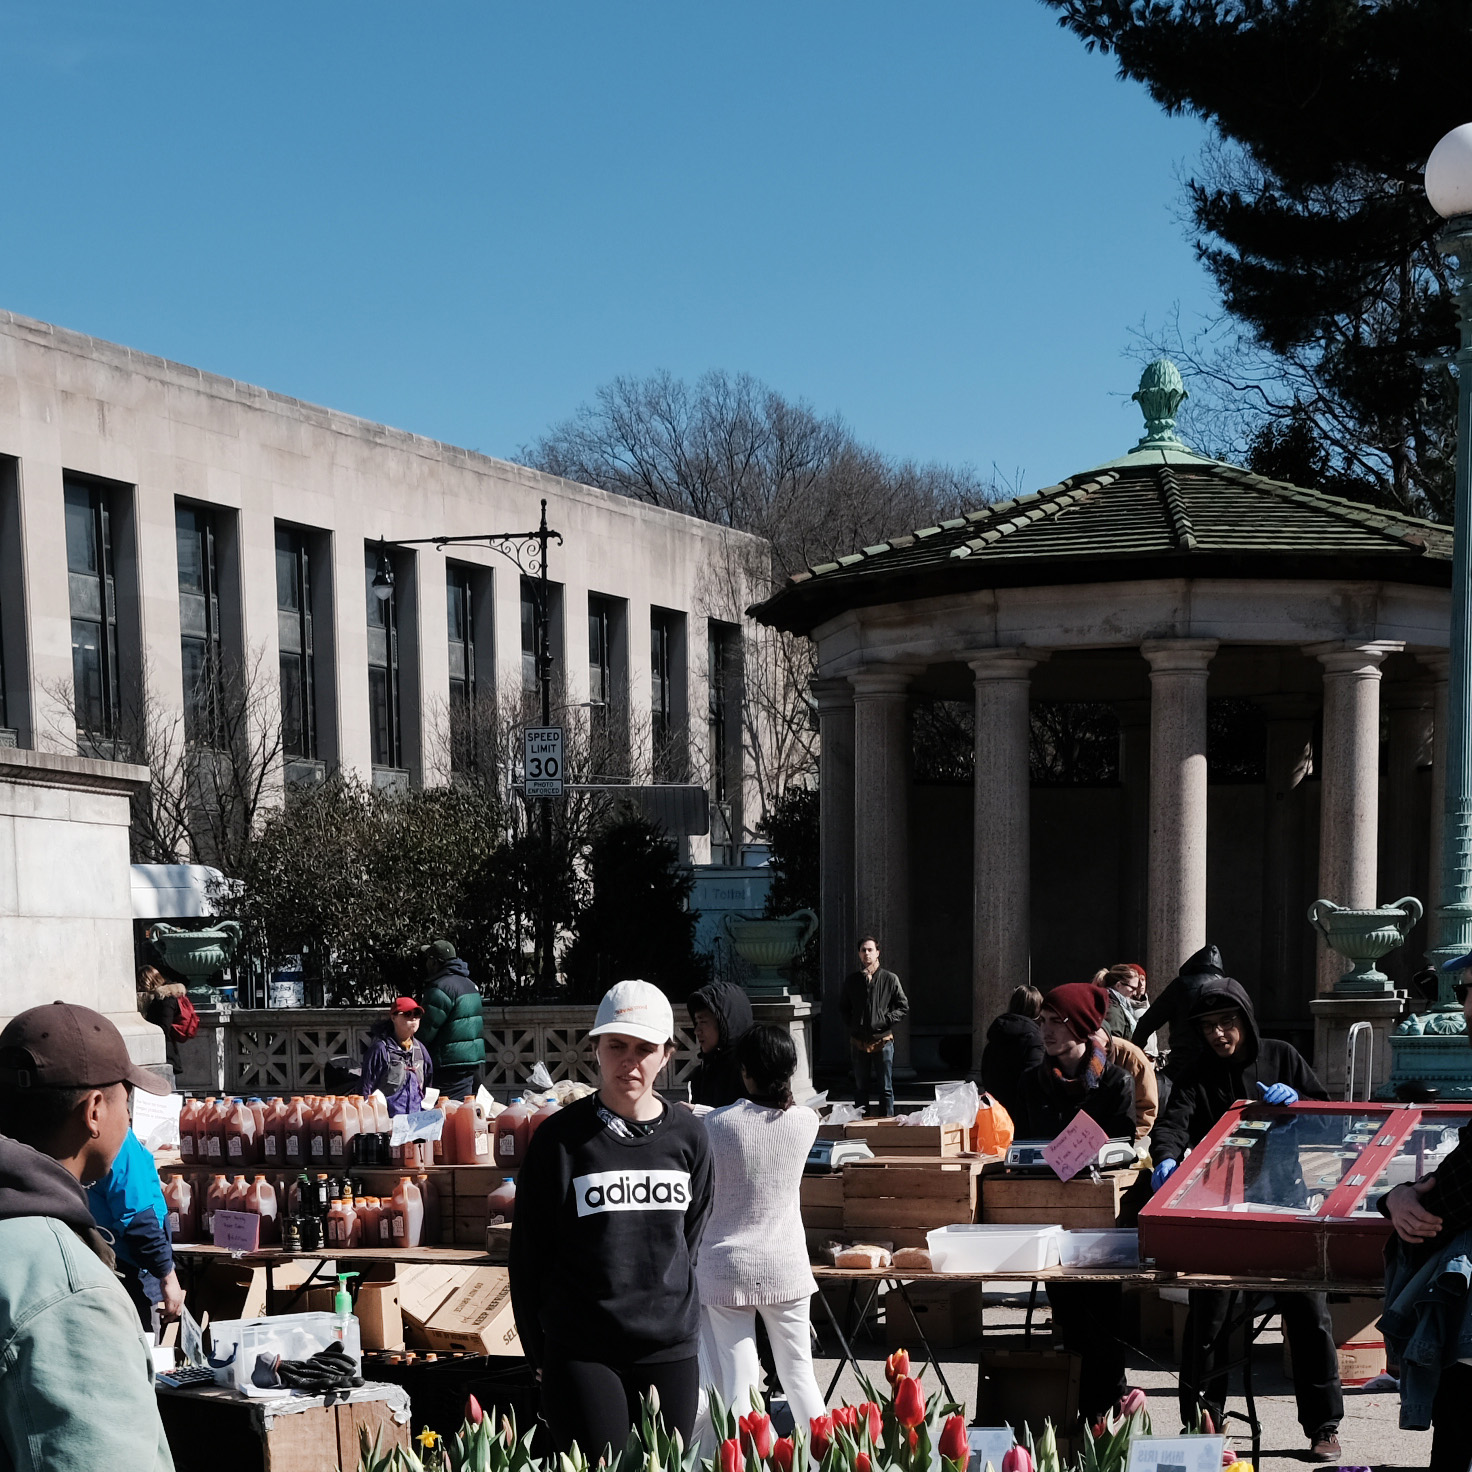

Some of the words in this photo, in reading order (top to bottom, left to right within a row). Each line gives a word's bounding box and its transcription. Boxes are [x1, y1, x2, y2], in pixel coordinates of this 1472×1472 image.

[528, 733, 560, 741] SPEED
[531, 744, 556, 753] LIMIT
[530, 757, 558, 777] 30
[585, 1176, 686, 1208] adidas
